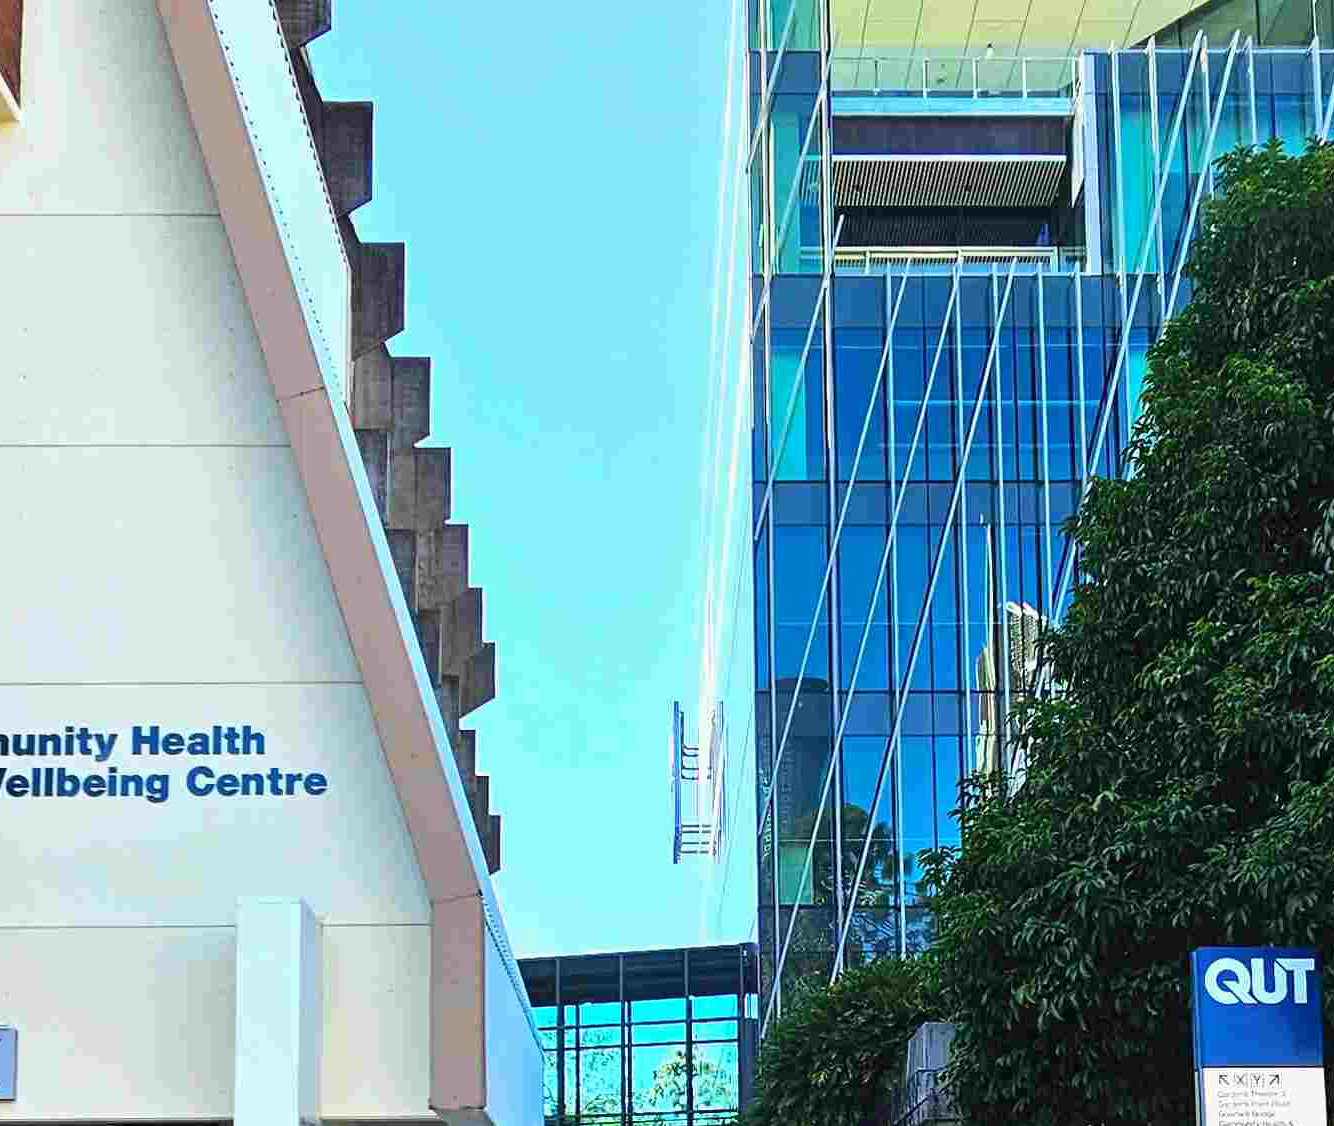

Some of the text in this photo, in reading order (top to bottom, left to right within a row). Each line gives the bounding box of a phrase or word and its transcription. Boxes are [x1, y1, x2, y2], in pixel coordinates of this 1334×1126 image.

[131, 724, 266, 756] Health
[185, 766, 328, 797] Centre
[1204, 957, 1316, 1005] QUT
